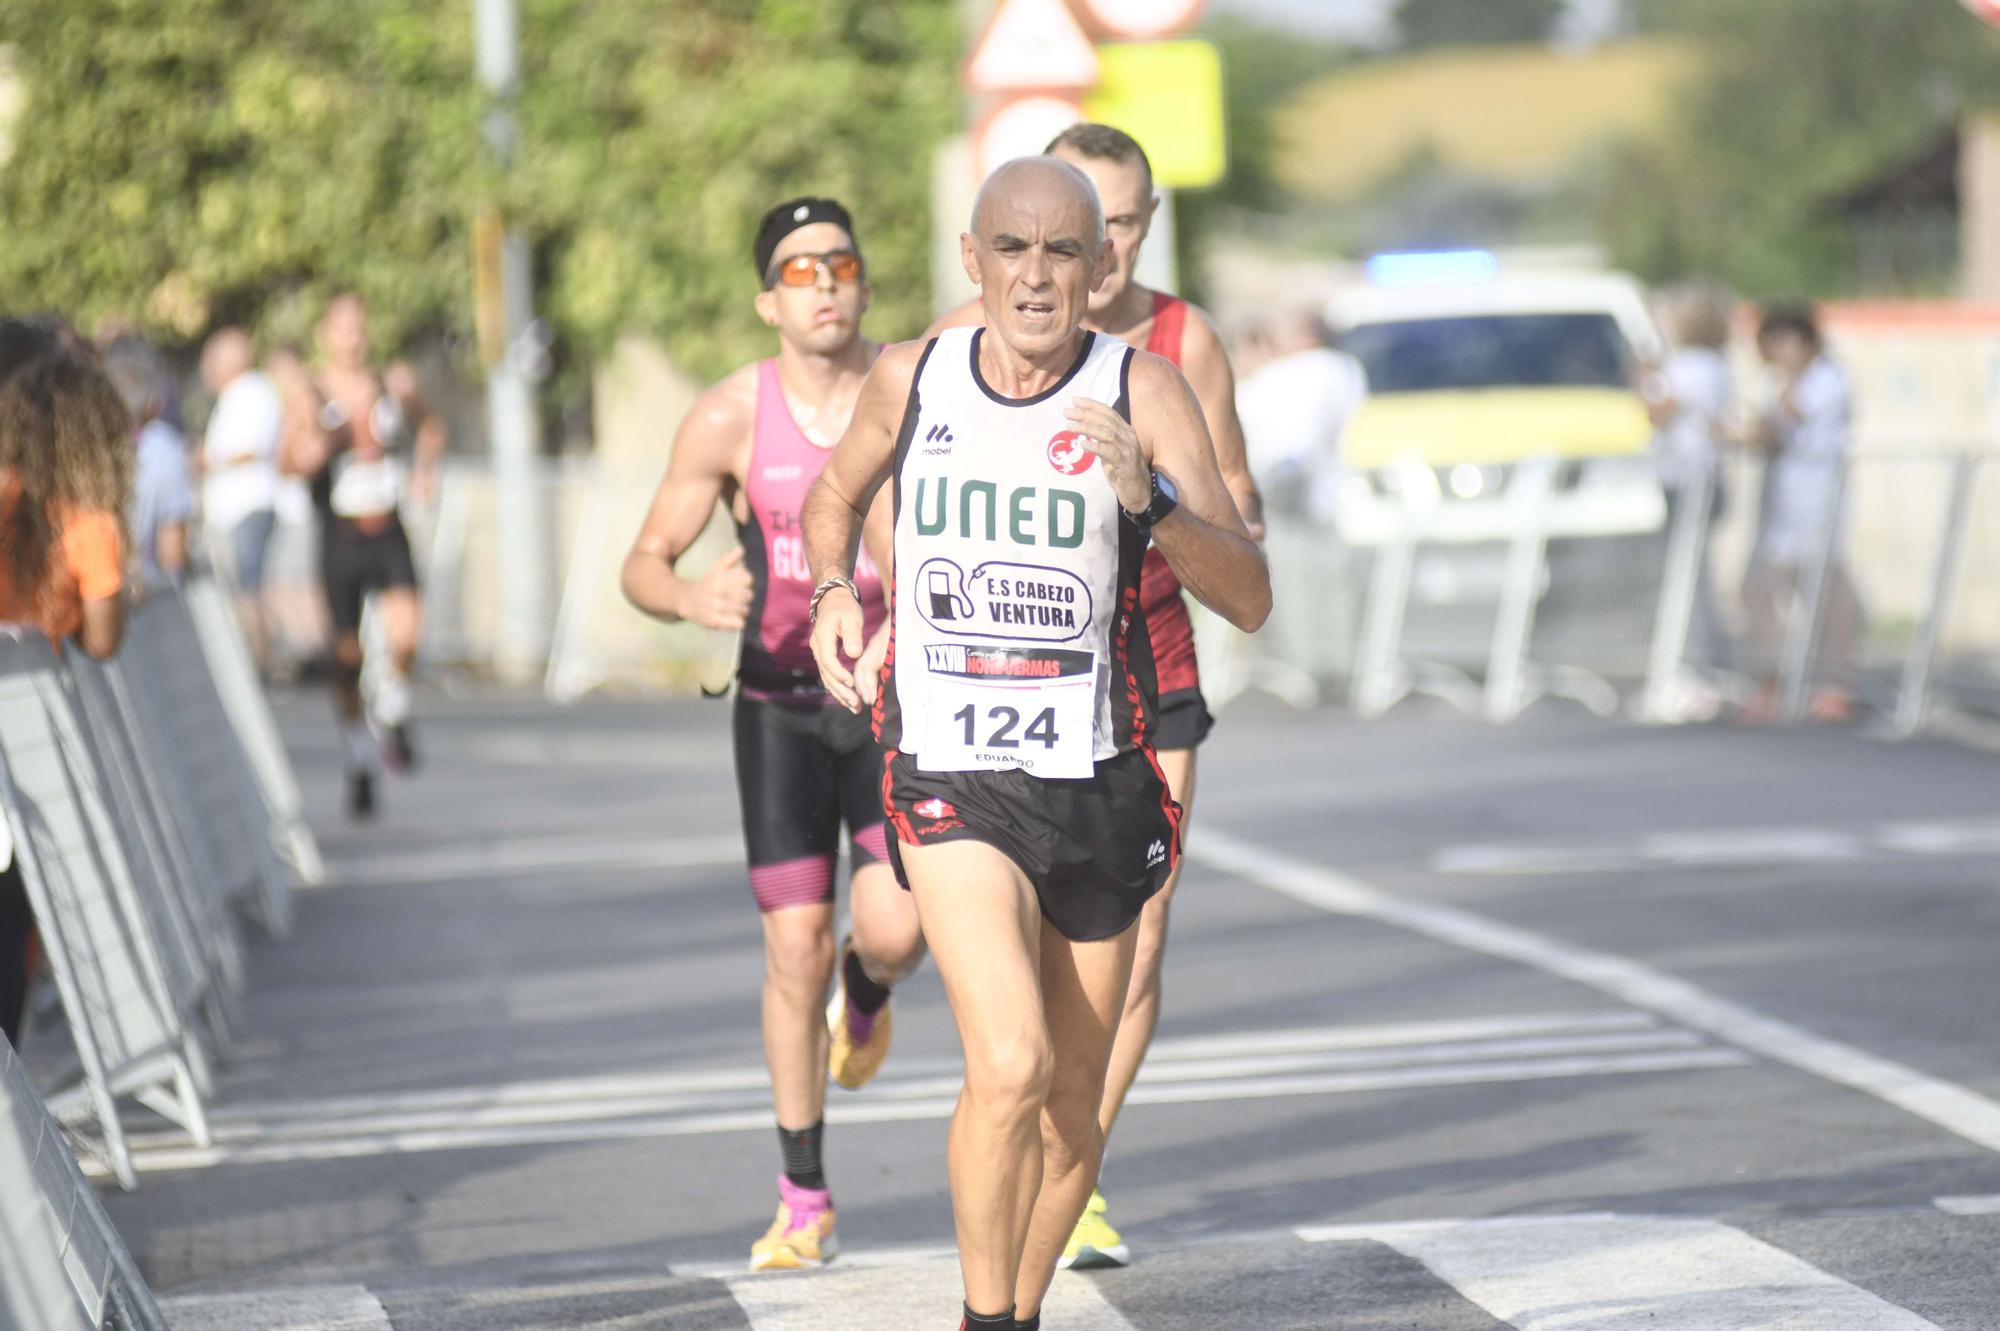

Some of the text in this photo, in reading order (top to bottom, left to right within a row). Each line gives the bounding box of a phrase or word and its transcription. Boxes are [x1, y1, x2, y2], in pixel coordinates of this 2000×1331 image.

[921, 447, 952, 455] mobel
[915, 477, 1086, 549] UNED
[987, 579, 1075, 603] E.S CABEZO
[989, 602, 1075, 629] VENTURA
[954, 704, 1059, 749] 124
[975, 754, 1034, 768] EDUARDO
